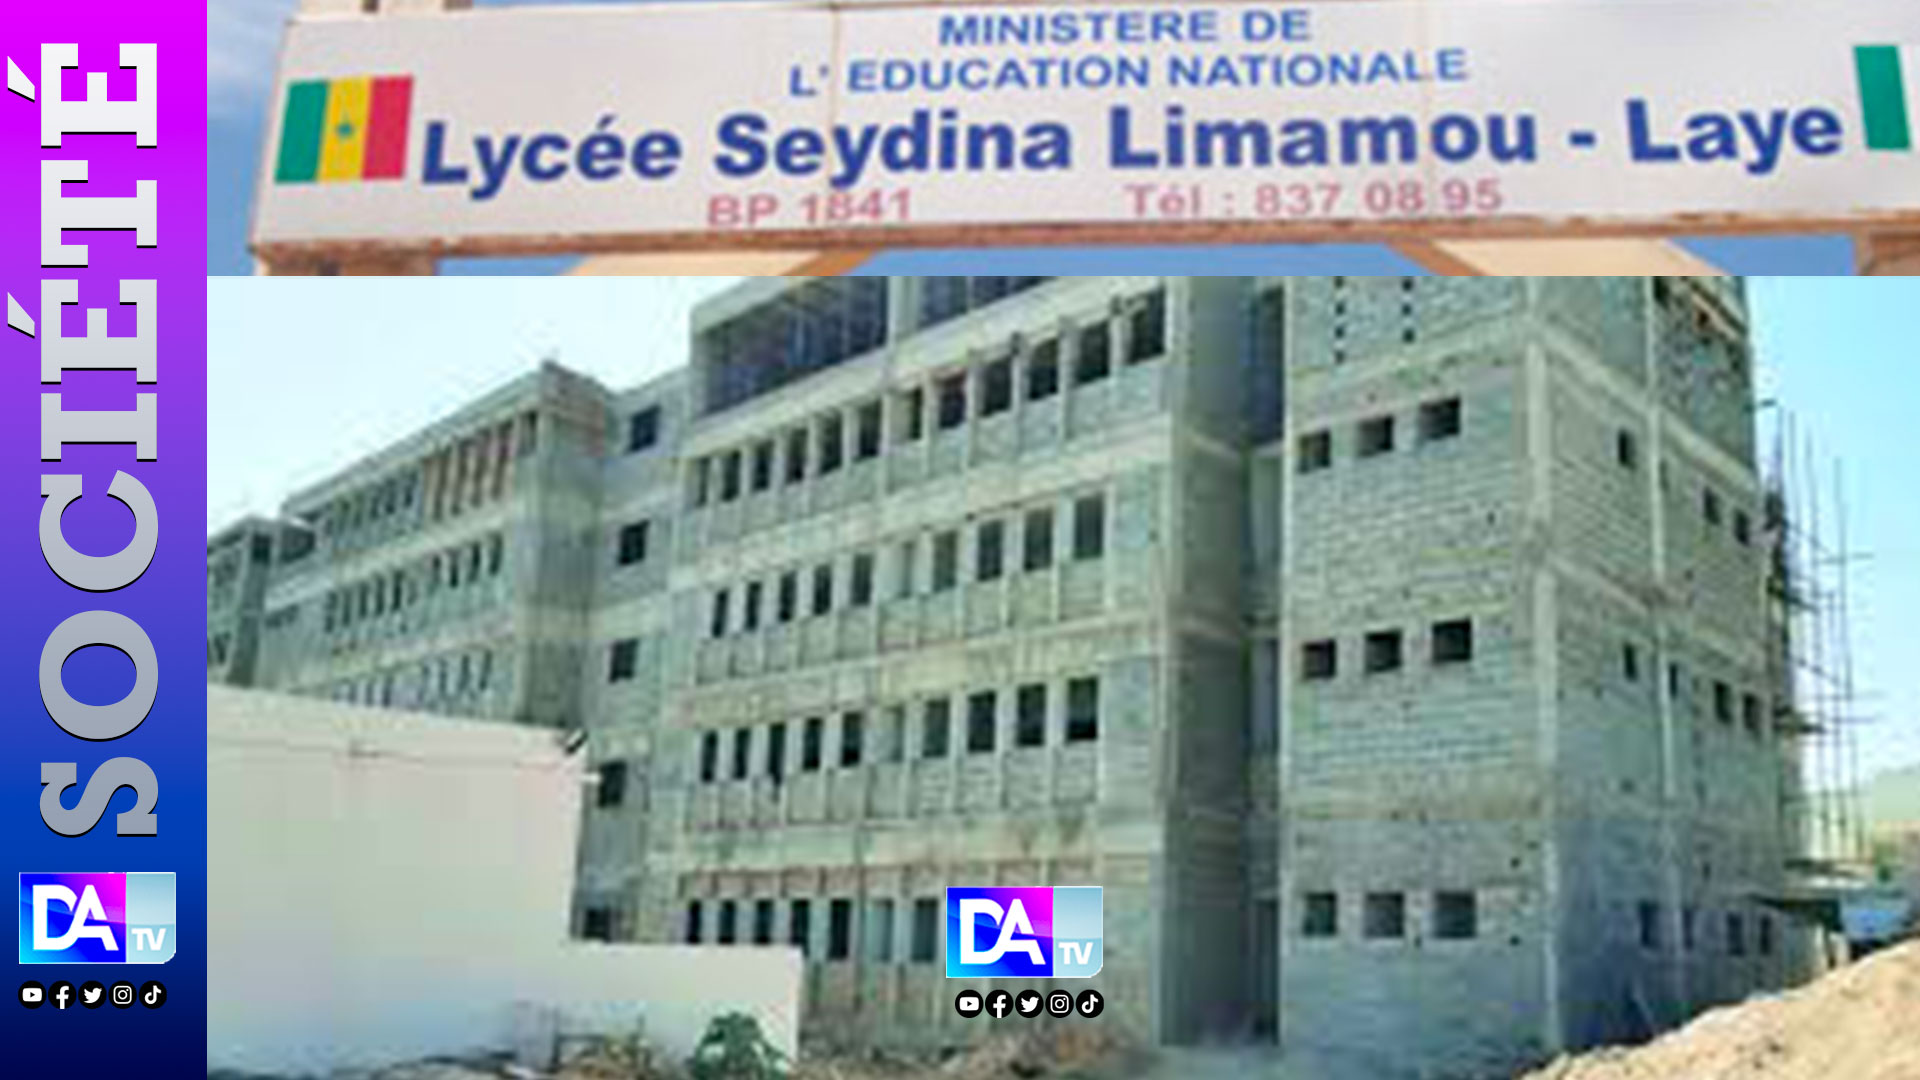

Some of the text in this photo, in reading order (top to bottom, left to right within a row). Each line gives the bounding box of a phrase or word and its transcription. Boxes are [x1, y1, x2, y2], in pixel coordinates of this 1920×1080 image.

[939, 9, 1313, 47] MINISTERE DE
[788, 48, 1469, 98] L' EDUCATION NATIONALE
[421, 115, 683, 200] Lycée
[713, 109, 1072, 188] Seydina
[1108, 105, 1537, 169] Limamou
[1624, 98, 1844, 176] Laye
[706, 188, 912, 227] BP 1841
[1124, 182, 1201, 218] Tél
[1254, 183, 1342, 216] 837
[1365, 181, 1426, 214] 08
[1441, 177, 1504, 213] 95
